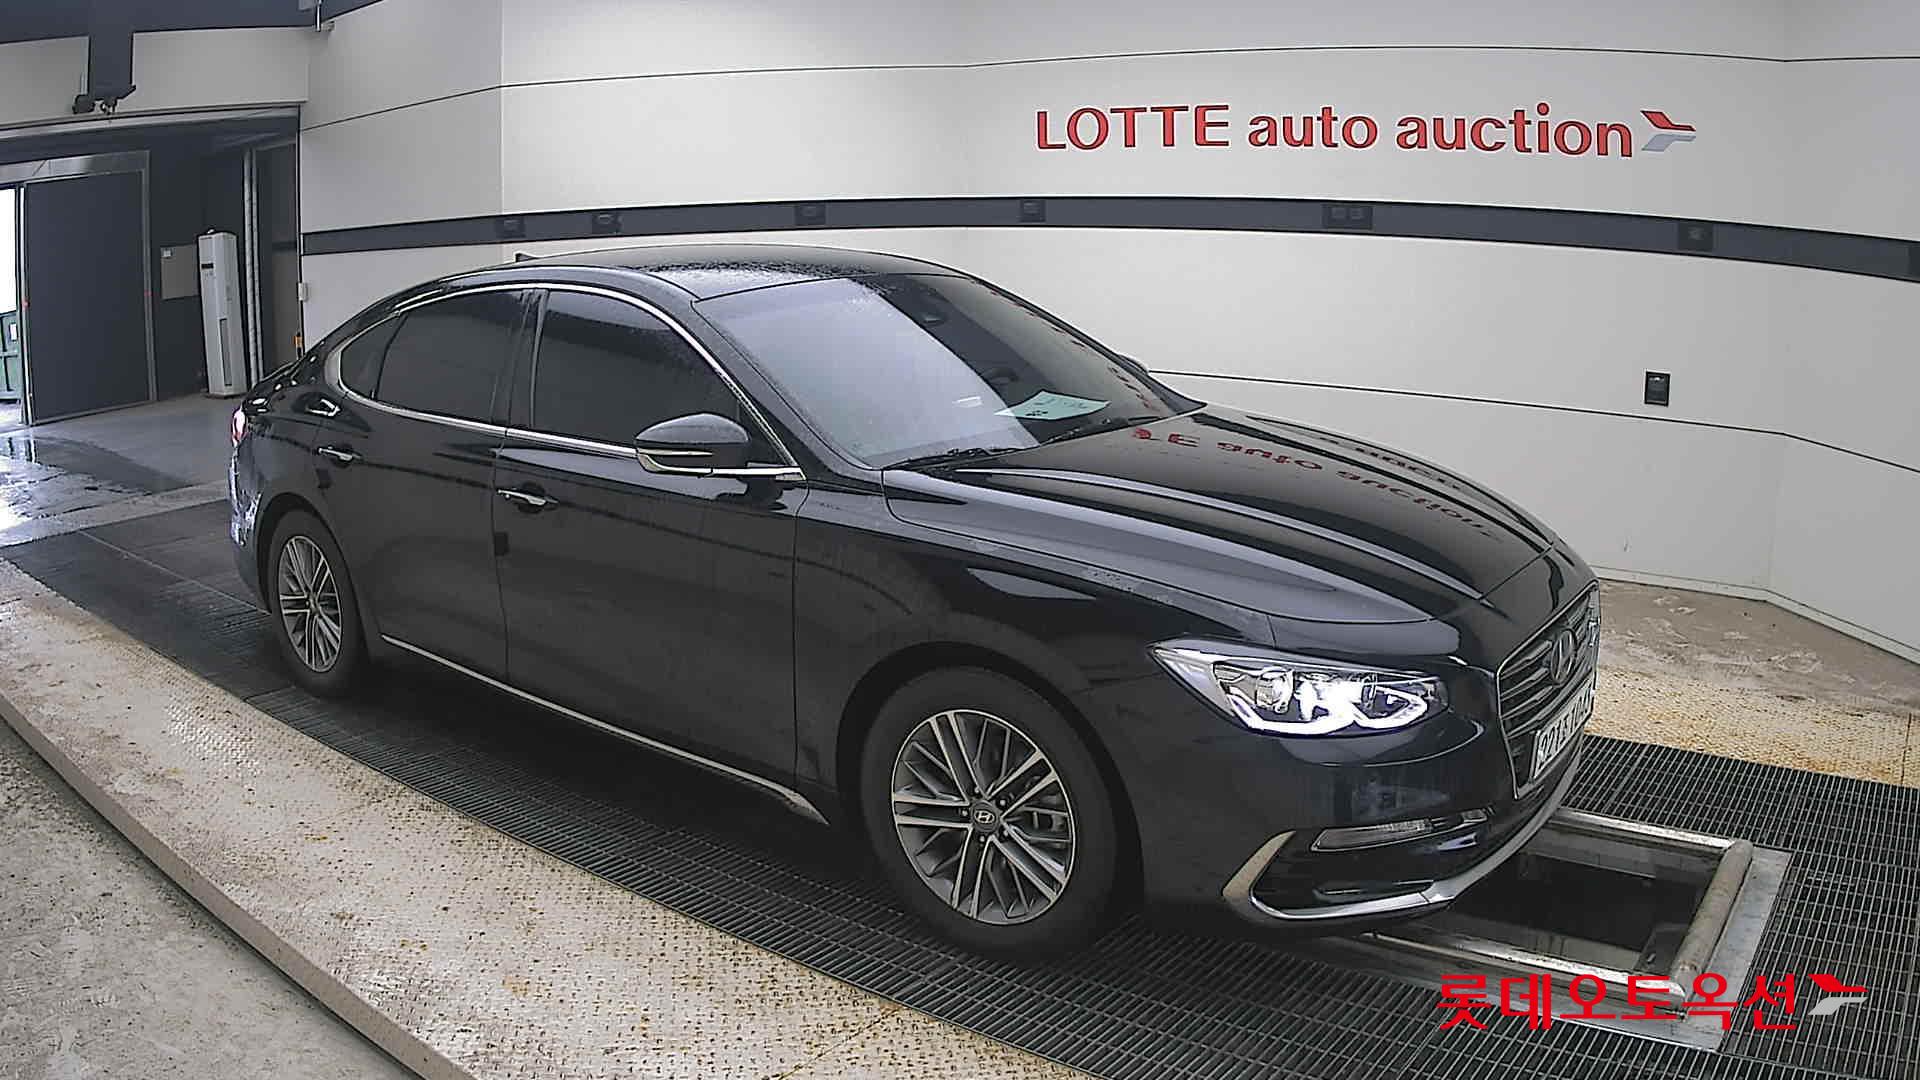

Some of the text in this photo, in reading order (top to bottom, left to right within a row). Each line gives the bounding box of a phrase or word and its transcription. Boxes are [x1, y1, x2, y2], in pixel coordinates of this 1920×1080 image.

[1036, 102, 1633, 158] LOTTE auto auction
